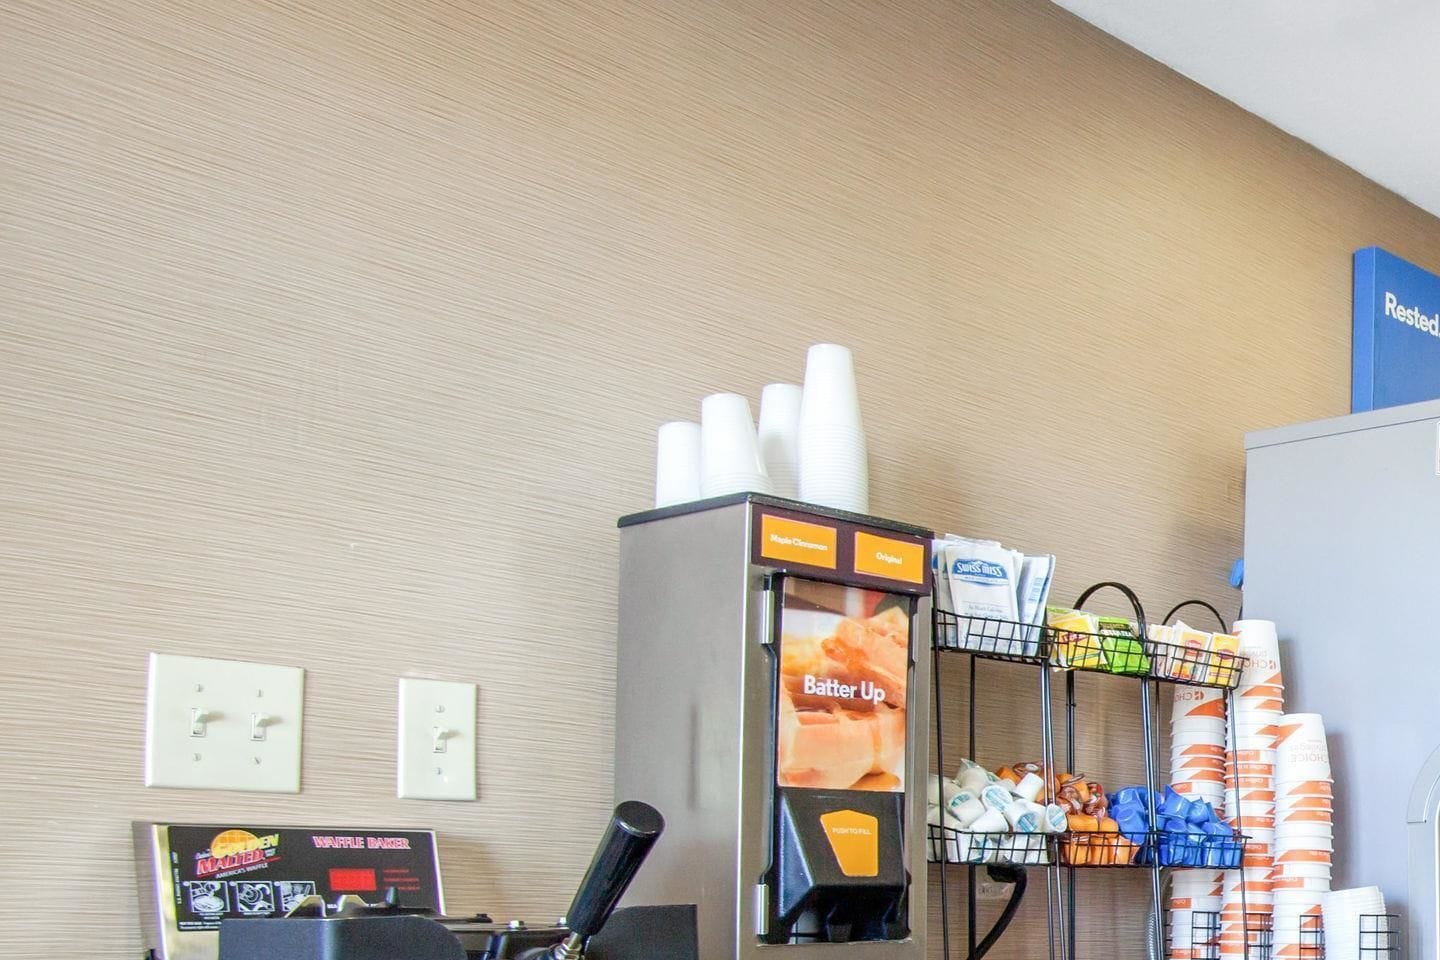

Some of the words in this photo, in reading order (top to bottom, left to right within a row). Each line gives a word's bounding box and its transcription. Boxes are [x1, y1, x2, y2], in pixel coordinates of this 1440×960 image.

[770, 533, 792, 545] Maple
[792, 539, 828, 551] Cinnamon
[876, 552, 903, 564] Original
[804, 674, 858, 698] Batter
[860, 680, 886, 705] Up
[313, 836, 365, 849] WAFFLE
[367, 838, 411, 850] BAKER
[197, 849, 265, 875] MALTED
